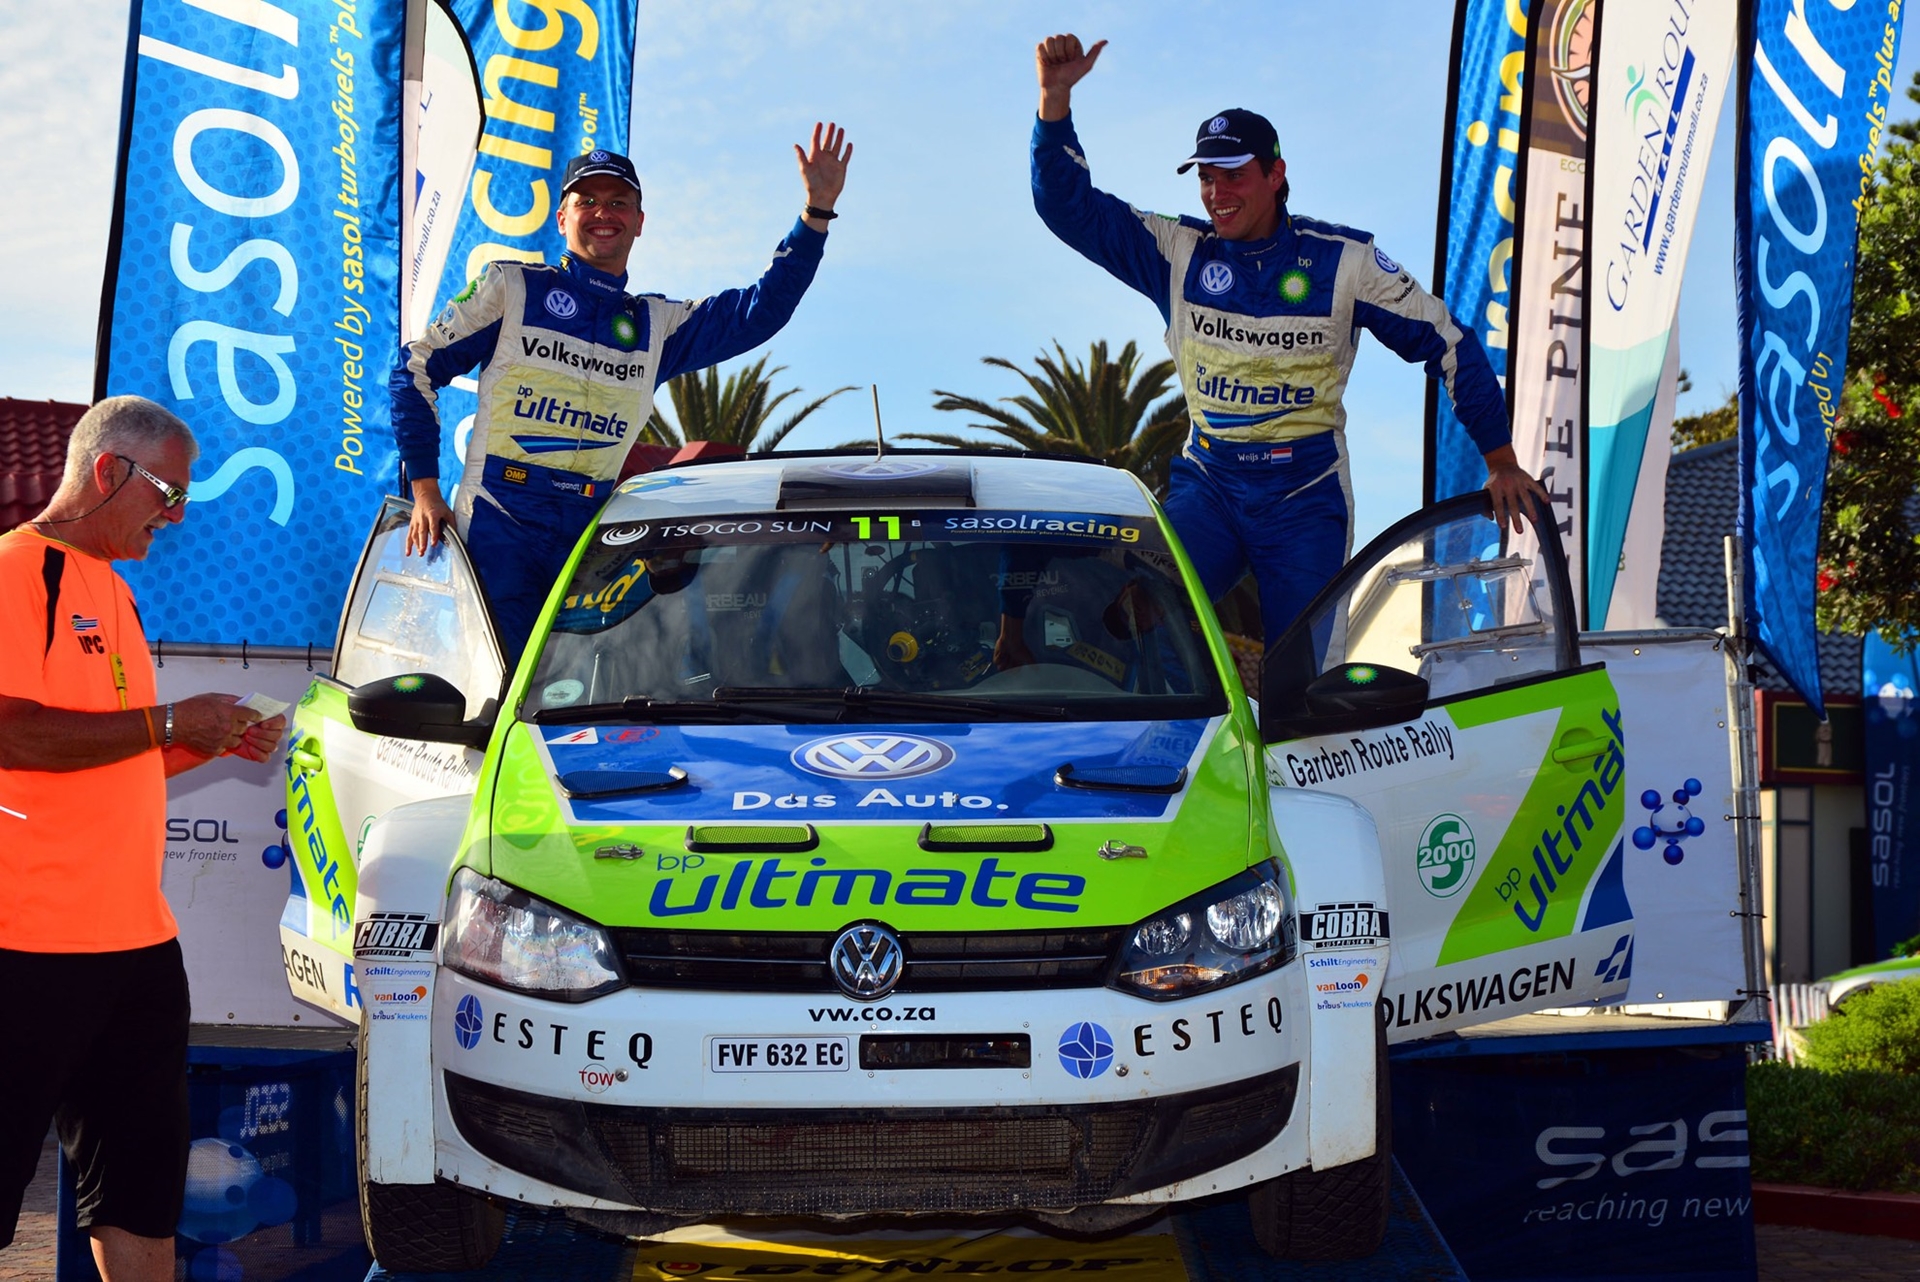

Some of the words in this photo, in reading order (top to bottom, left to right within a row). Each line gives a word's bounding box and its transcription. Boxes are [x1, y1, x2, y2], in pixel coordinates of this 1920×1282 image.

[1874, 22, 1896, 94] plus
[1606, 108, 1663, 312] GARDEN
[1656, 0, 1696, 101] ROU
[1653, 72, 1709, 276] www.gardenroutemall.co.za
[333, 210, 365, 295] sasol
[1297, 256, 1313, 268] bp
[334, 295, 371, 336] by
[1190, 311, 1324, 351] Volkswagen
[521, 336, 645, 381] Volkswagen
[517, 384, 533, 398] bp
[1196, 376, 1316, 405] ultimate
[334, 337, 365, 476] Powered
[513, 396, 629, 440] ultimate
[1260, 451, 1271, 460] Jr
[505, 468, 527, 481] OMP
[660, 521, 762, 538] TSOGO
[769, 520, 832, 533] SUN
[850, 516, 900, 540] 11
[944, 514, 1141, 543] sasolracing
[1286, 747, 1357, 788] Garden
[1351, 729, 1410, 773] Route
[1408, 720, 1456, 761] Rally
[731, 791, 837, 811] Das
[856, 788, 1009, 810] Auto.
[188, 848, 238, 864] frontiers
[656, 853, 706, 873] bp
[1419, 839, 1475, 867] 2000
[648, 857, 1087, 918] ultimate
[1494, 866, 1522, 903] bp
[355, 921, 428, 949] COBRA
[1311, 911, 1381, 940] COBRA
[397, 1012, 428, 1020] keukens
[807, 1006, 937, 1022] vw.co.za
[1342, 1001, 1373, 1009] keukens
[493, 1012, 654, 1070] ESTEQ
[1133, 996, 1283, 1057] ESTEQ
[718, 1044, 759, 1067] FVF
[766, 1044, 808, 1067] 632
[816, 1043, 844, 1066] EC
[1523, 1191, 1669, 1228] reaching
[1682, 1195, 1752, 1218] new
[732, 1256, 1146, 1277] DUNLOP
